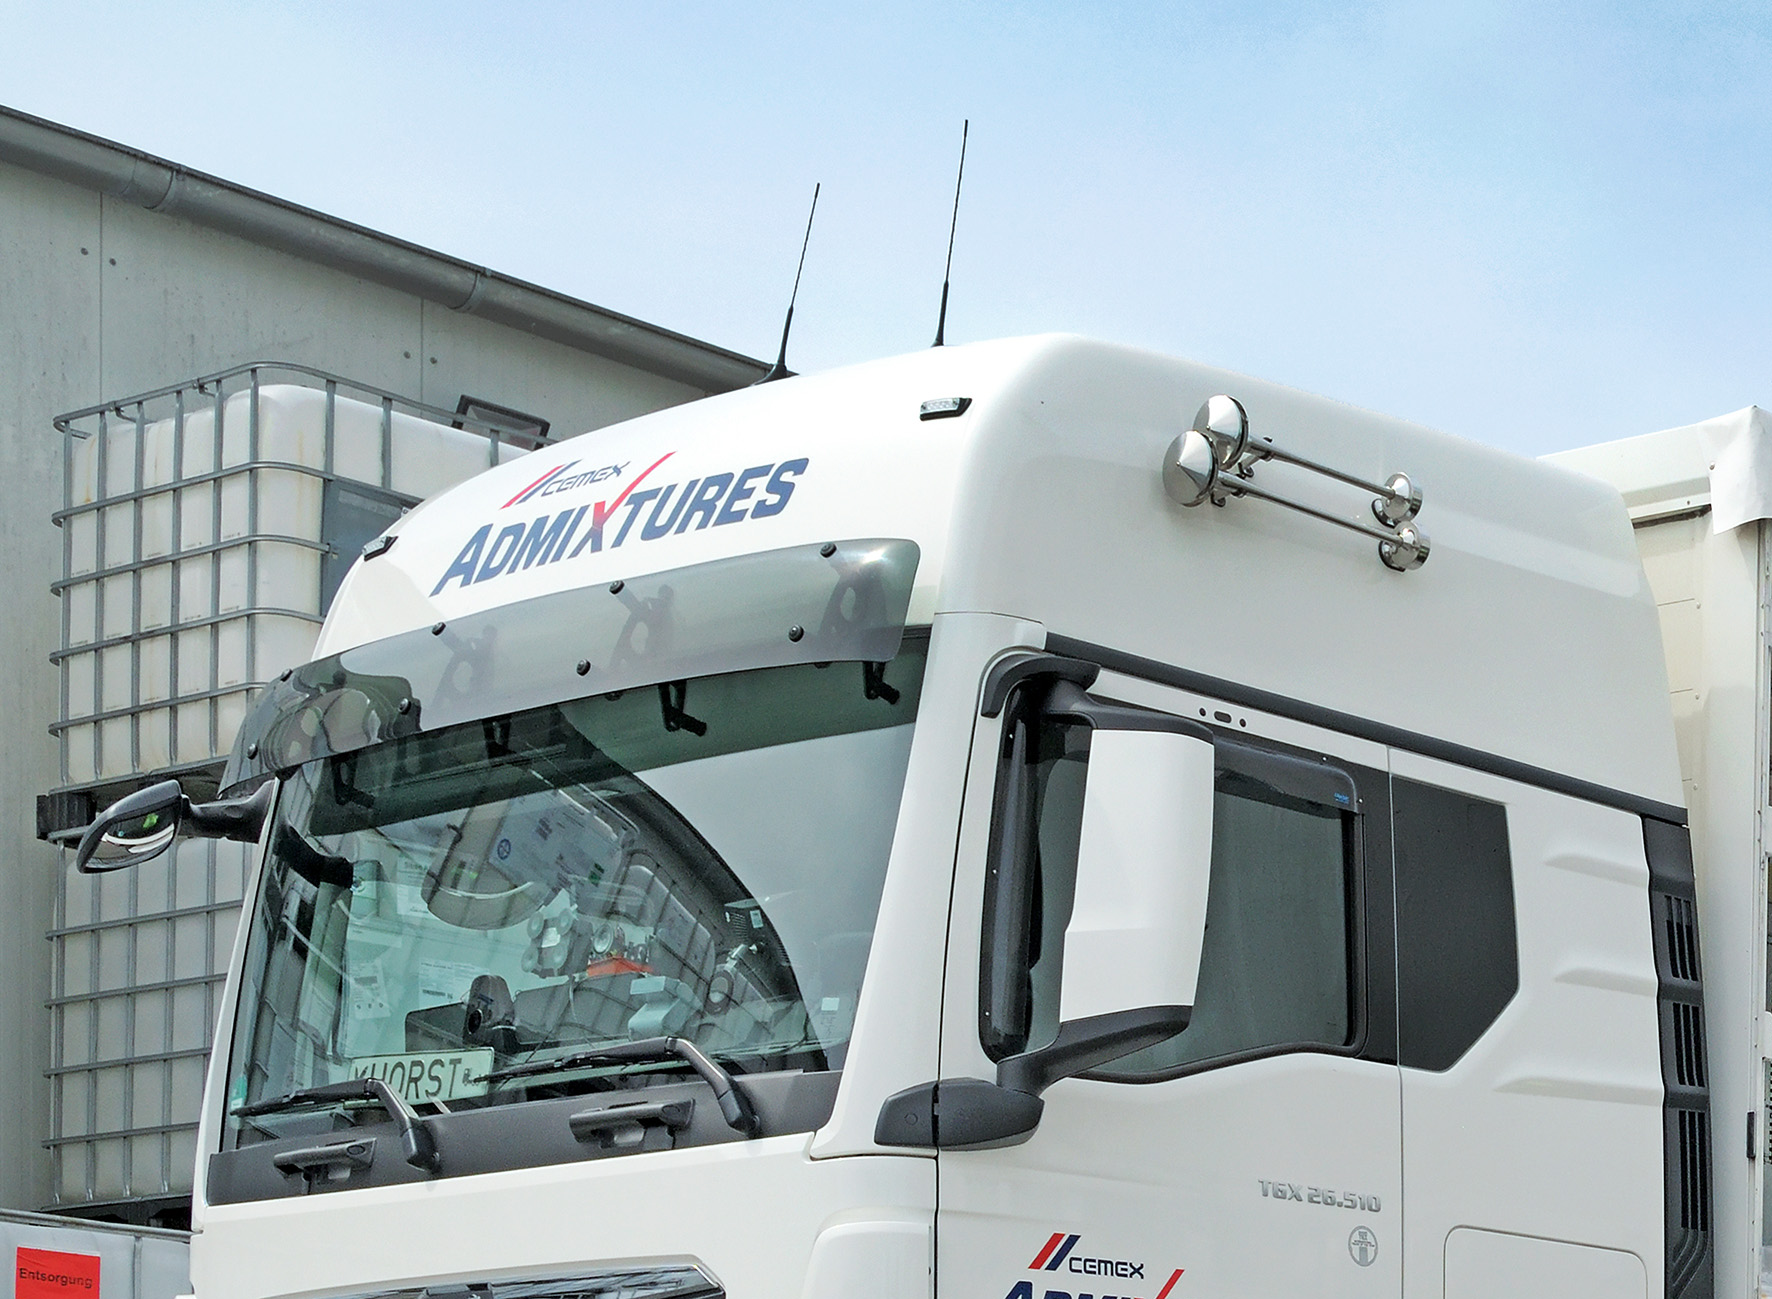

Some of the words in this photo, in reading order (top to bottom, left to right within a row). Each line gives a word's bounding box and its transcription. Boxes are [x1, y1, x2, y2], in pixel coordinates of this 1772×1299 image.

[429, 451, 809, 597] ADMIXTURES
[1258, 1180, 1303, 1202] TGX
[1307, 1186, 1381, 1213] 26.510
[19, 1268, 93, 1289] Entsorgung
[1068, 1257, 1144, 1279] CEMEX
